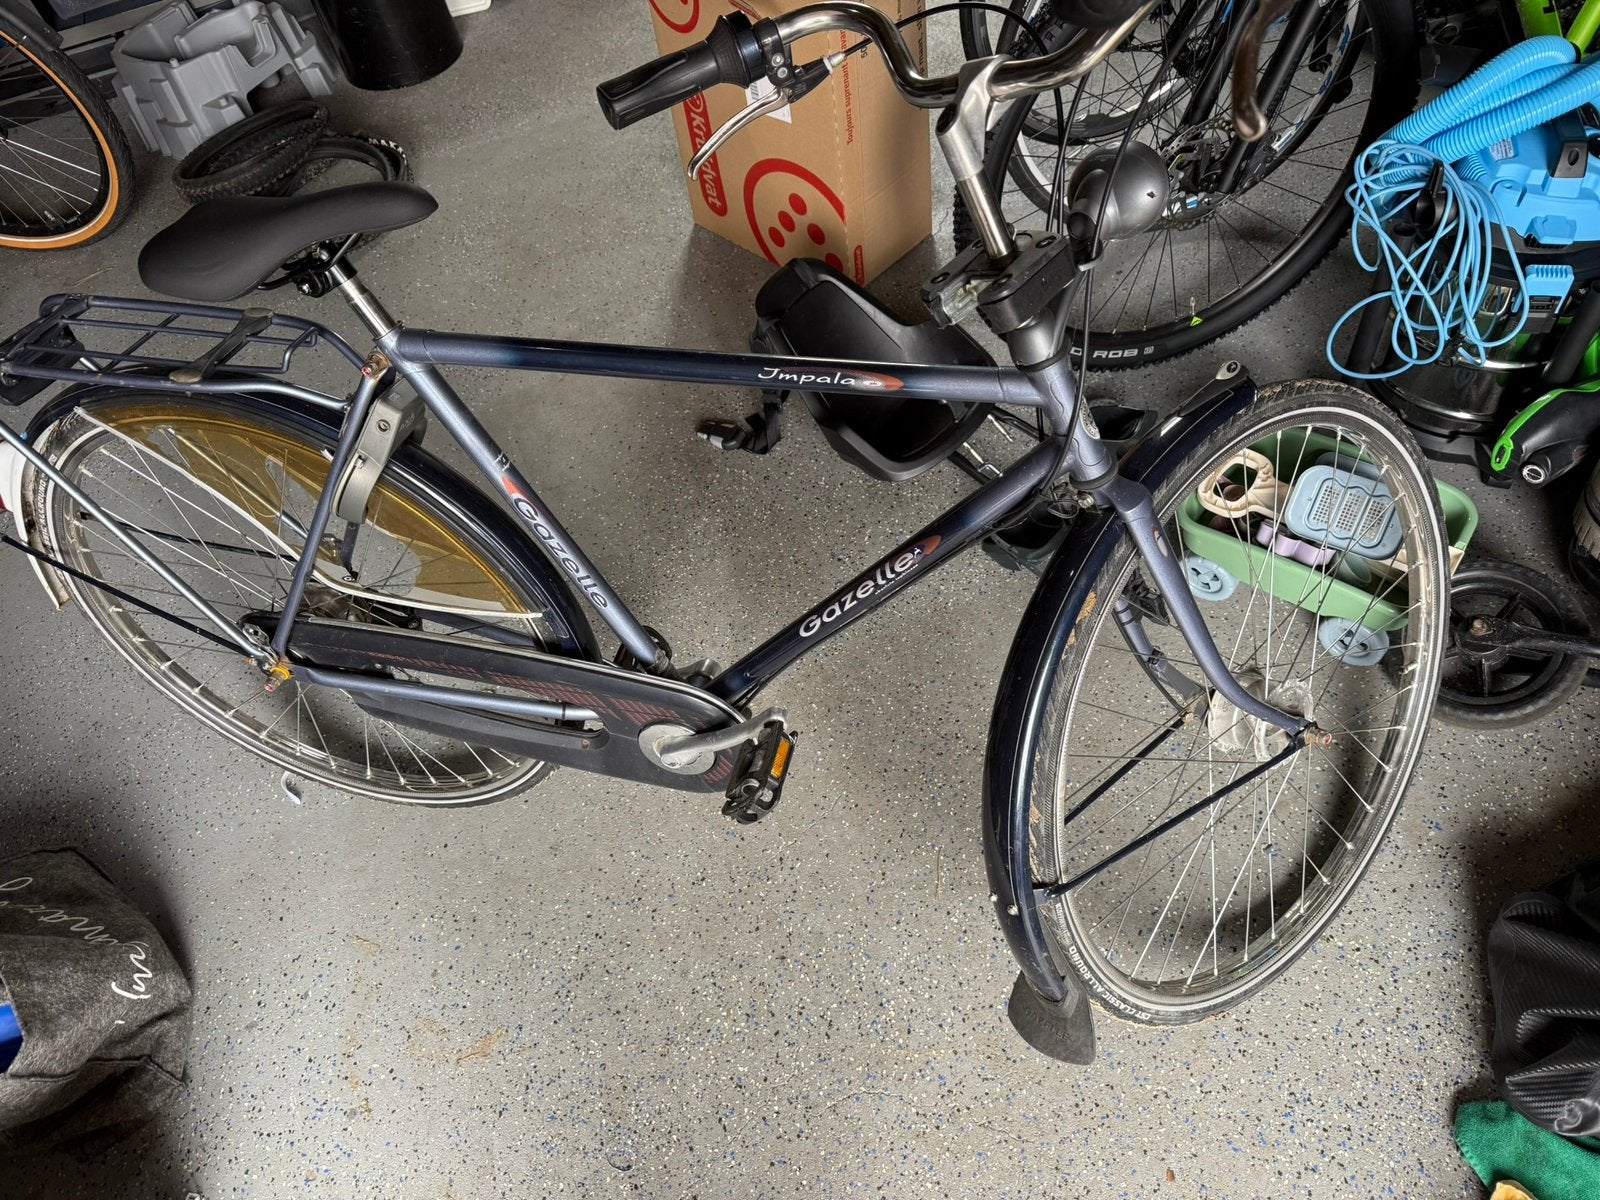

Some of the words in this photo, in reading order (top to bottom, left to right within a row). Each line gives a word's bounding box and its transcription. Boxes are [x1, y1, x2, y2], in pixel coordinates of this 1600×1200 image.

[845, 108, 855, 145] Toujours
[694, 112, 722, 209] Krudvat
[1092, 347, 1139, 359] ROB
[514, 498, 609, 609] Gazelle
[799, 552, 914, 638] Gazelle
[1068, 945, 1106, 996] ALLROUND
[1102, 990, 1136, 1016] CLASSIC
[1135, 1009, 1152, 1020] CST
